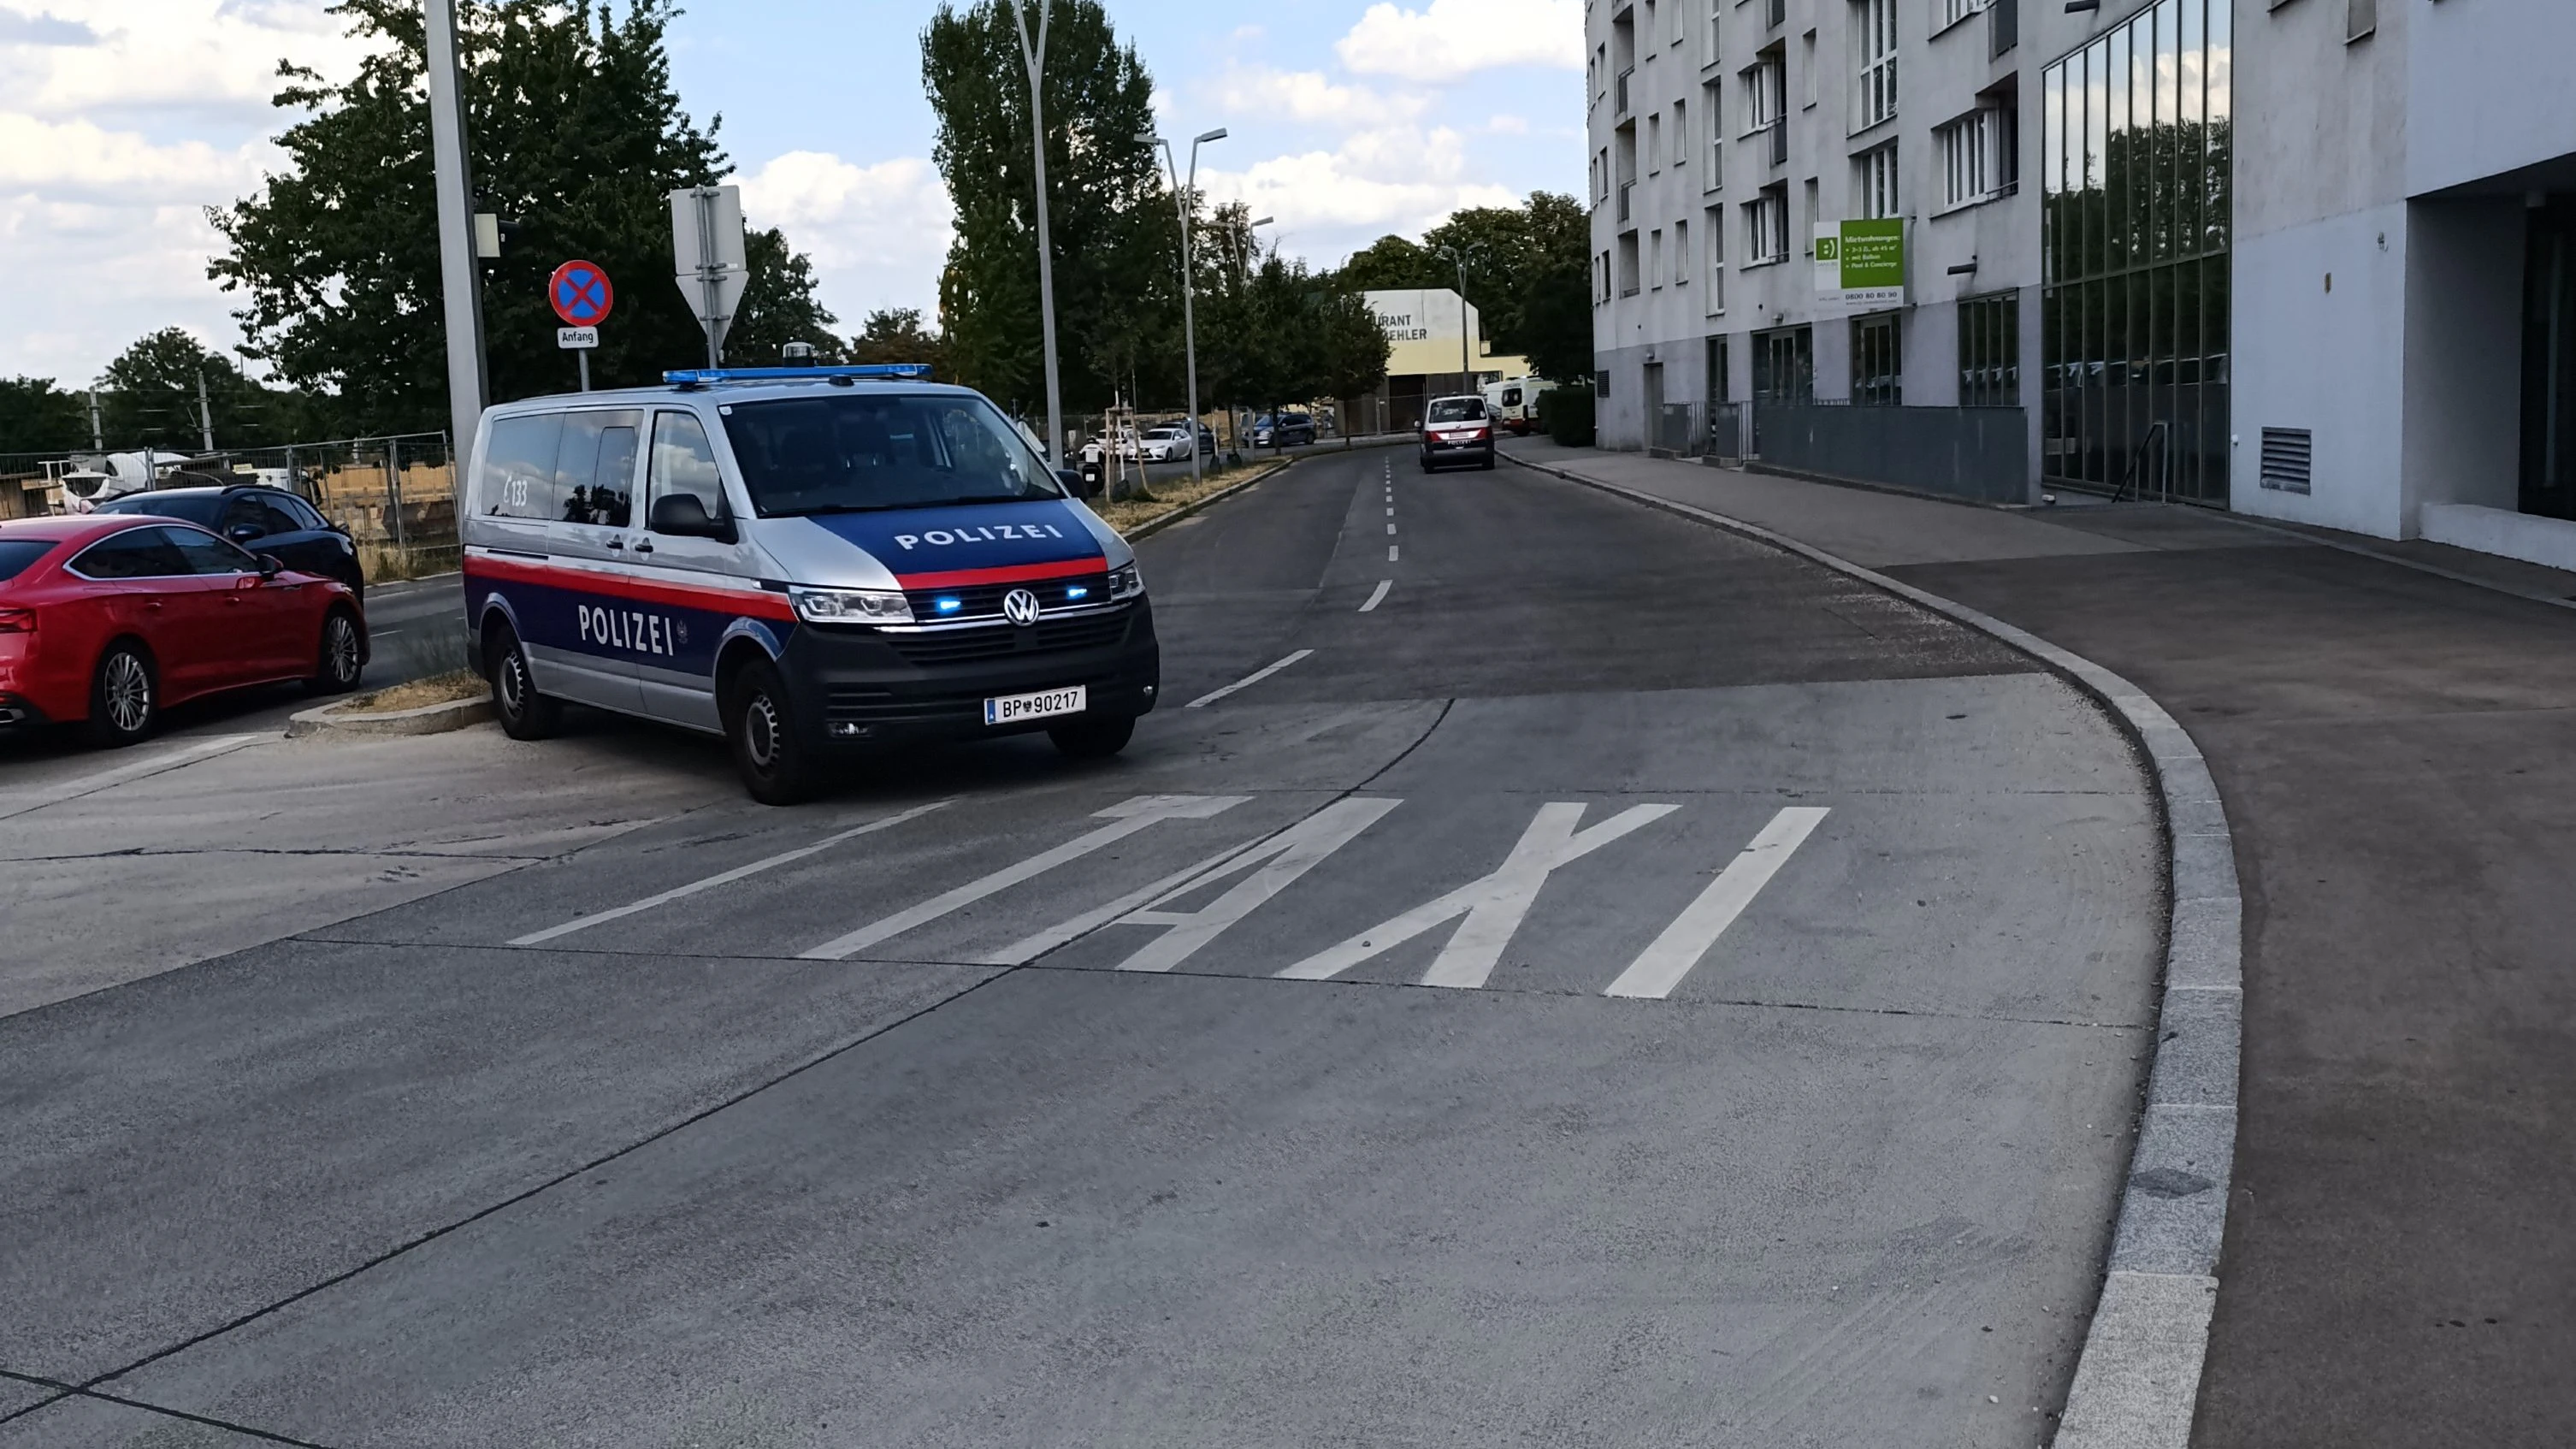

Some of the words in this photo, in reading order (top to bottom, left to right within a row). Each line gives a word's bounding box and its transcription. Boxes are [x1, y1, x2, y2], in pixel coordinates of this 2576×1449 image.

[1374, 314, 1411, 327] URANT
[562, 331, 594, 344] Anfang
[1386, 328, 1427, 341] EHLER
[511, 480, 528, 506] 133
[895, 524, 1063, 550] POLIZEI
[578, 605, 674, 656] POLIZEI
[797, 794, 1832, 998] TAXI
